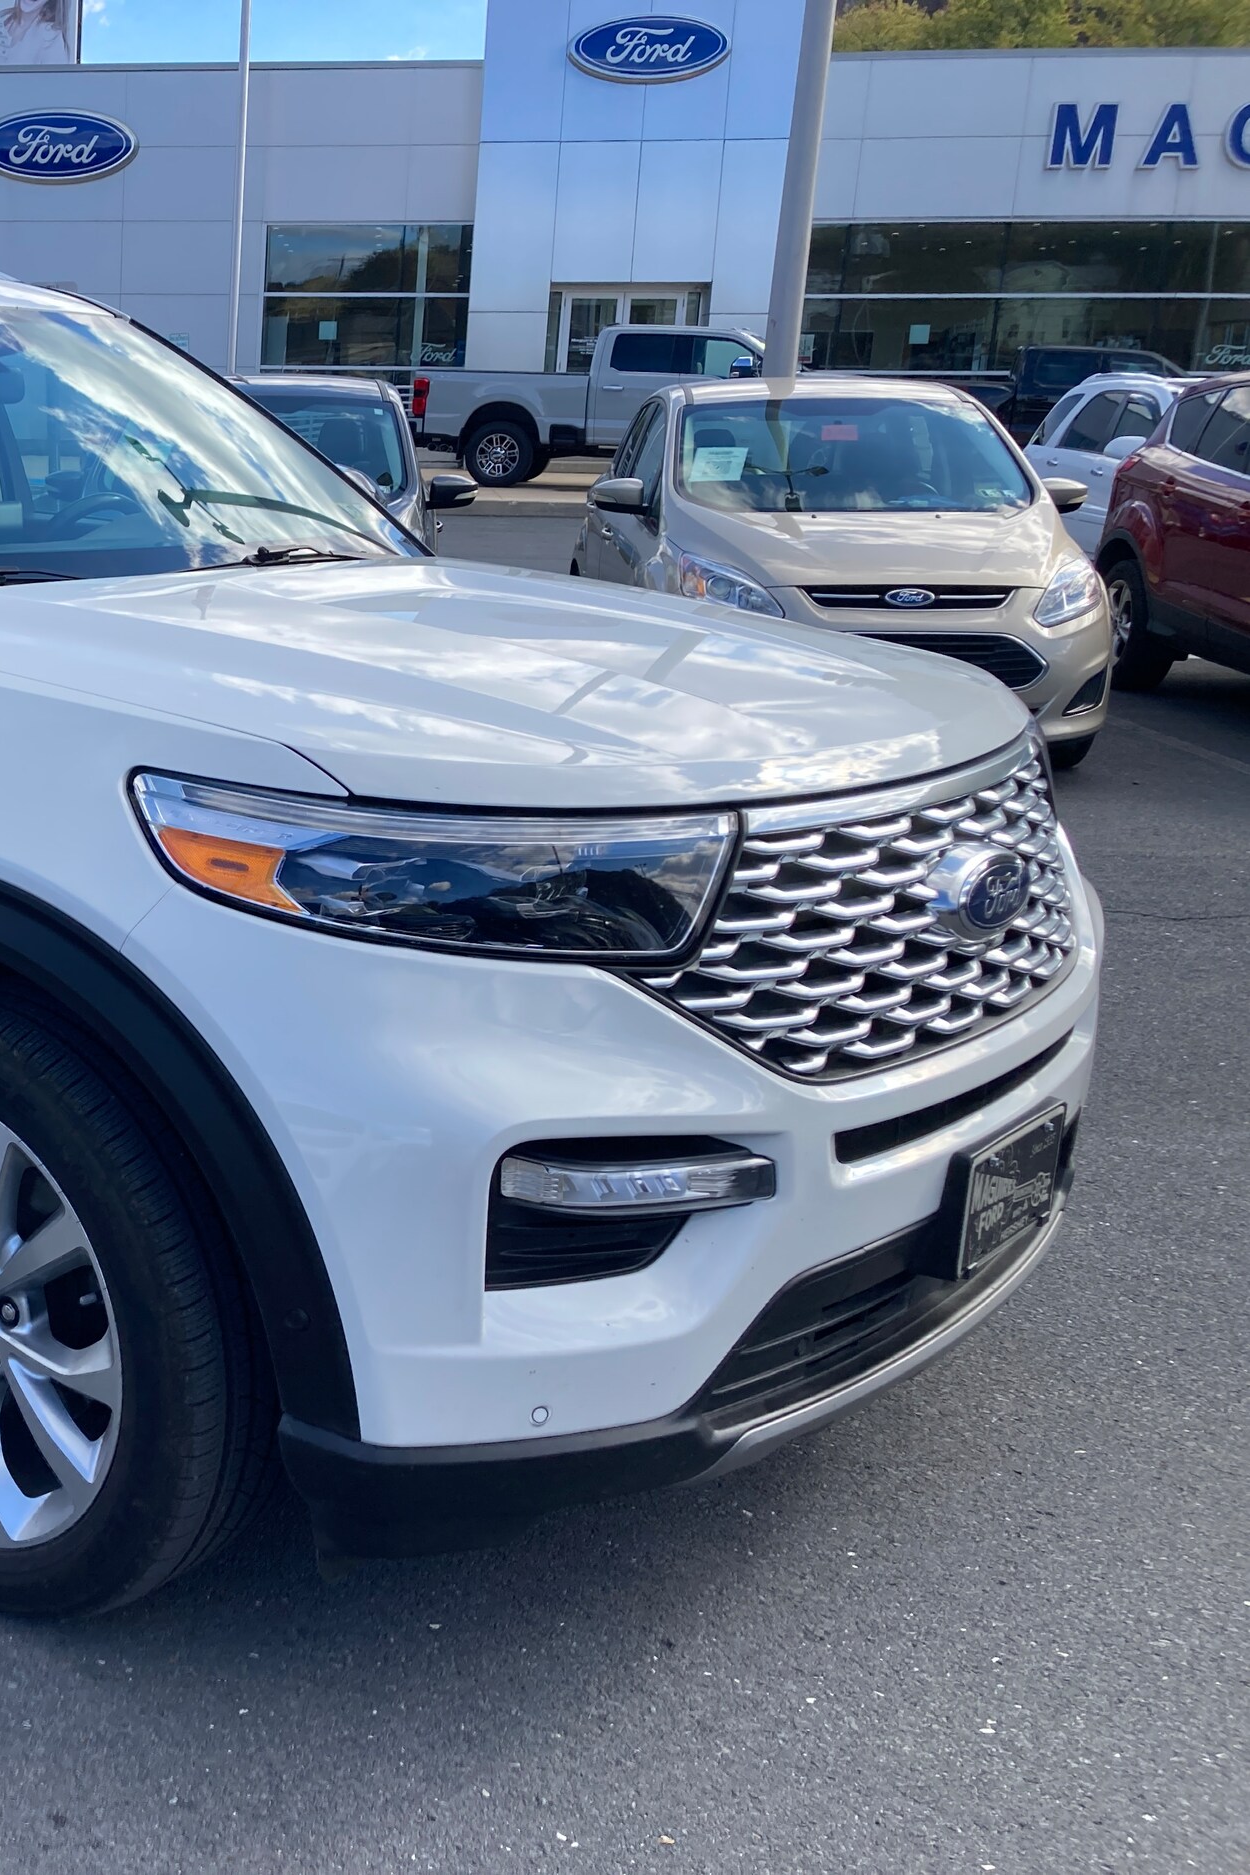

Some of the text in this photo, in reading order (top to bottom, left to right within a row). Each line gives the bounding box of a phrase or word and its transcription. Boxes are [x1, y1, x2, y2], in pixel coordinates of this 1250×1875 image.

[605, 27, 696, 65] Ford
[8, 124, 99, 165] Ford
[411, 342, 457, 362] Ford
[897, 590, 924, 602] Ford
[984, 872, 1019, 919] Ford
[977, 1201, 1004, 1241] FORD
